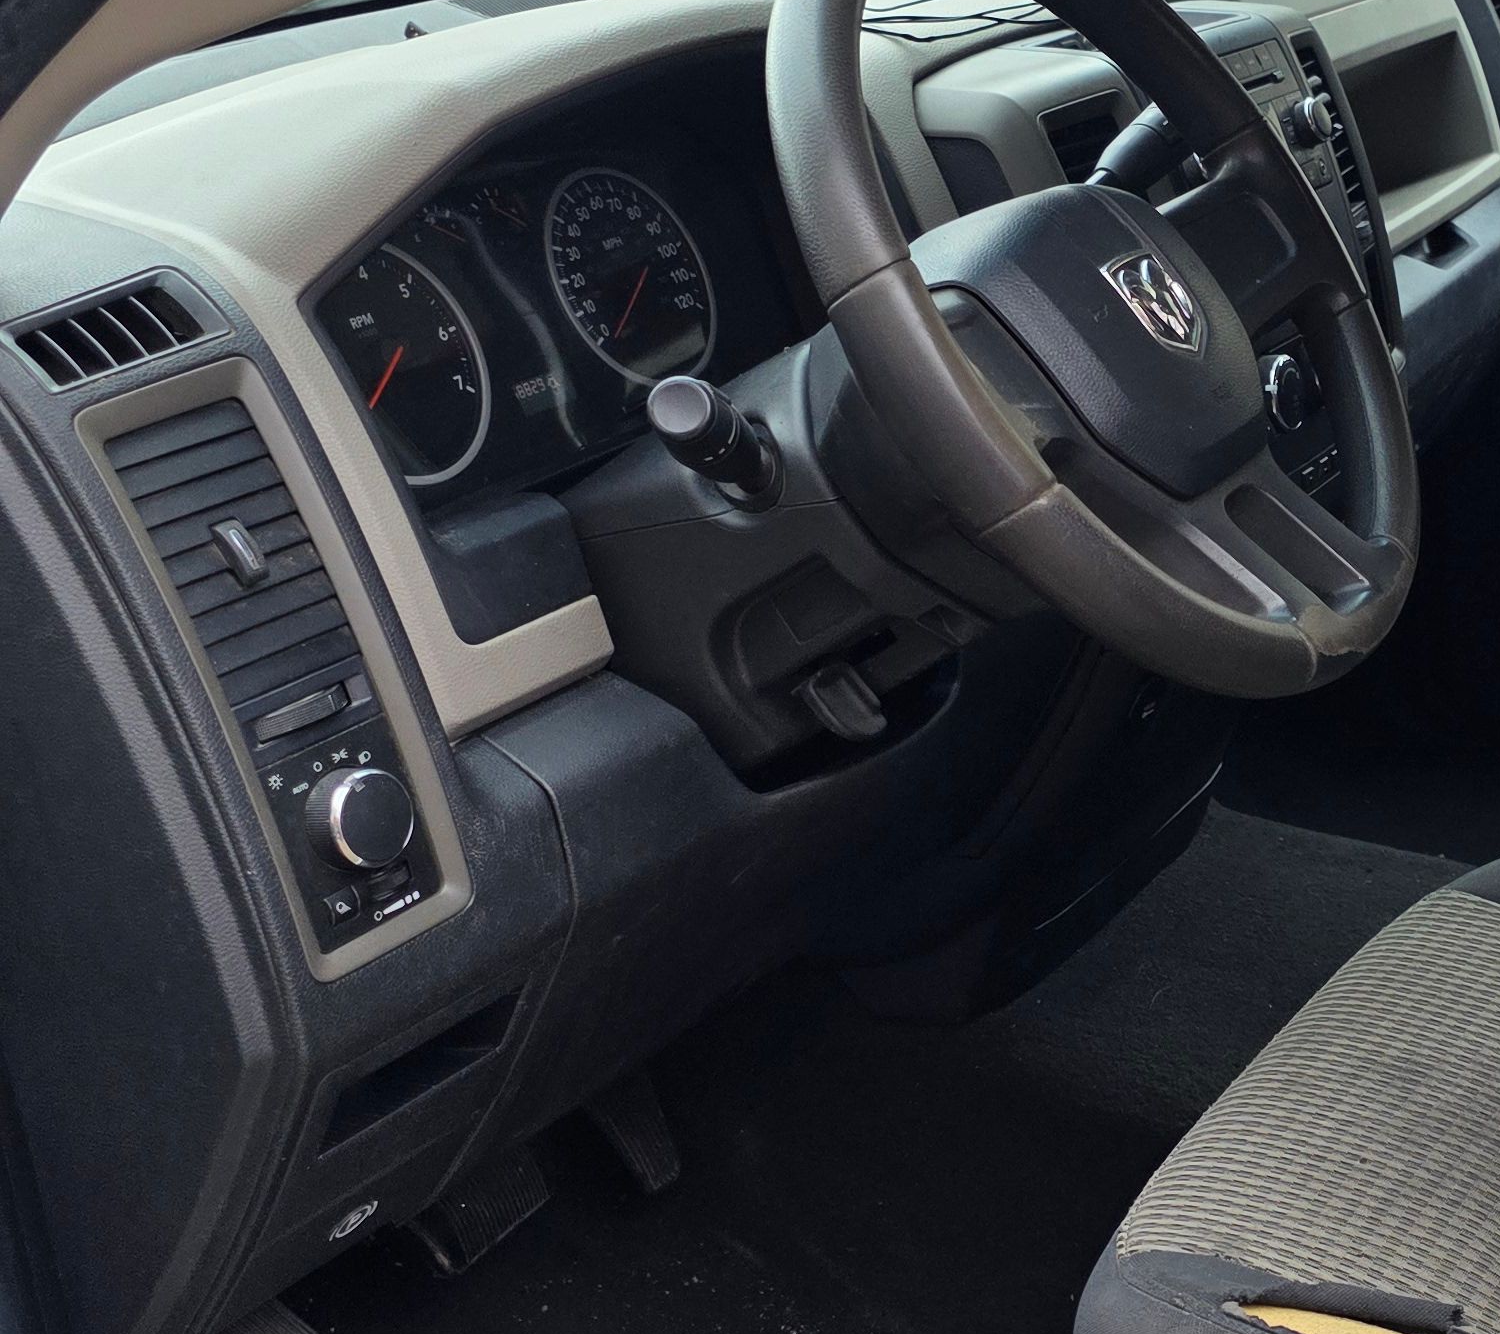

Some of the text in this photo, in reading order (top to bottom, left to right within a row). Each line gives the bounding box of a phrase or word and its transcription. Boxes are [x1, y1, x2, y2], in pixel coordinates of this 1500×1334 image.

[590, 196, 603, 210] 60
[606, 197, 622, 212] 70
[575, 206, 590, 222] 50
[626, 205, 642, 220] 80
[567, 223, 581, 238] 40
[646, 221, 661, 235] 90
[602, 236, 624, 251] MPH
[657, 242, 678, 259] 100
[566, 246, 581, 261] 30
[359, 265, 369, 281] 4
[670, 268, 689, 284] 110
[571, 273, 586, 289] 20
[399, 283, 411, 299] 5
[582, 299, 597, 314] 10
[674, 293, 695, 310] 120
[349, 312, 375, 330] RPM
[438, 326, 449, 341] 6
[600, 324, 610, 337] 0
[453, 375, 463, 390] 7
